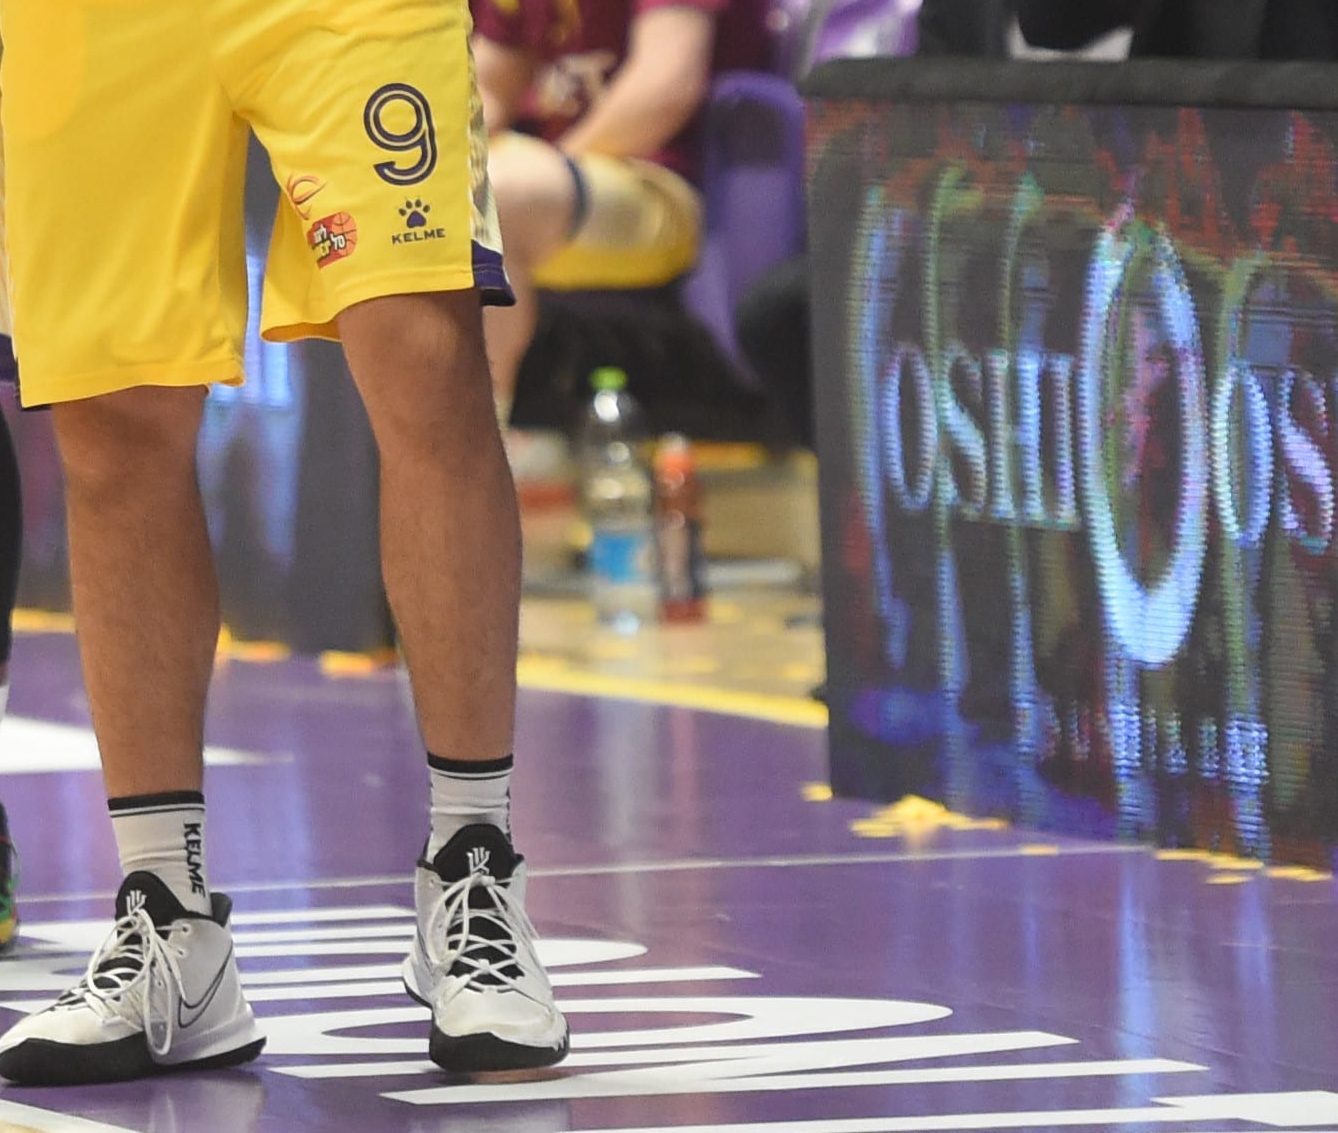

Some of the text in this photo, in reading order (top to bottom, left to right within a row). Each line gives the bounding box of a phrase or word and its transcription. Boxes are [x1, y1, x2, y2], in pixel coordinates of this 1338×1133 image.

[363, 83, 437, 186] 9
[391, 228, 446, 245] KELME
[183, 822, 206, 898] KELME
